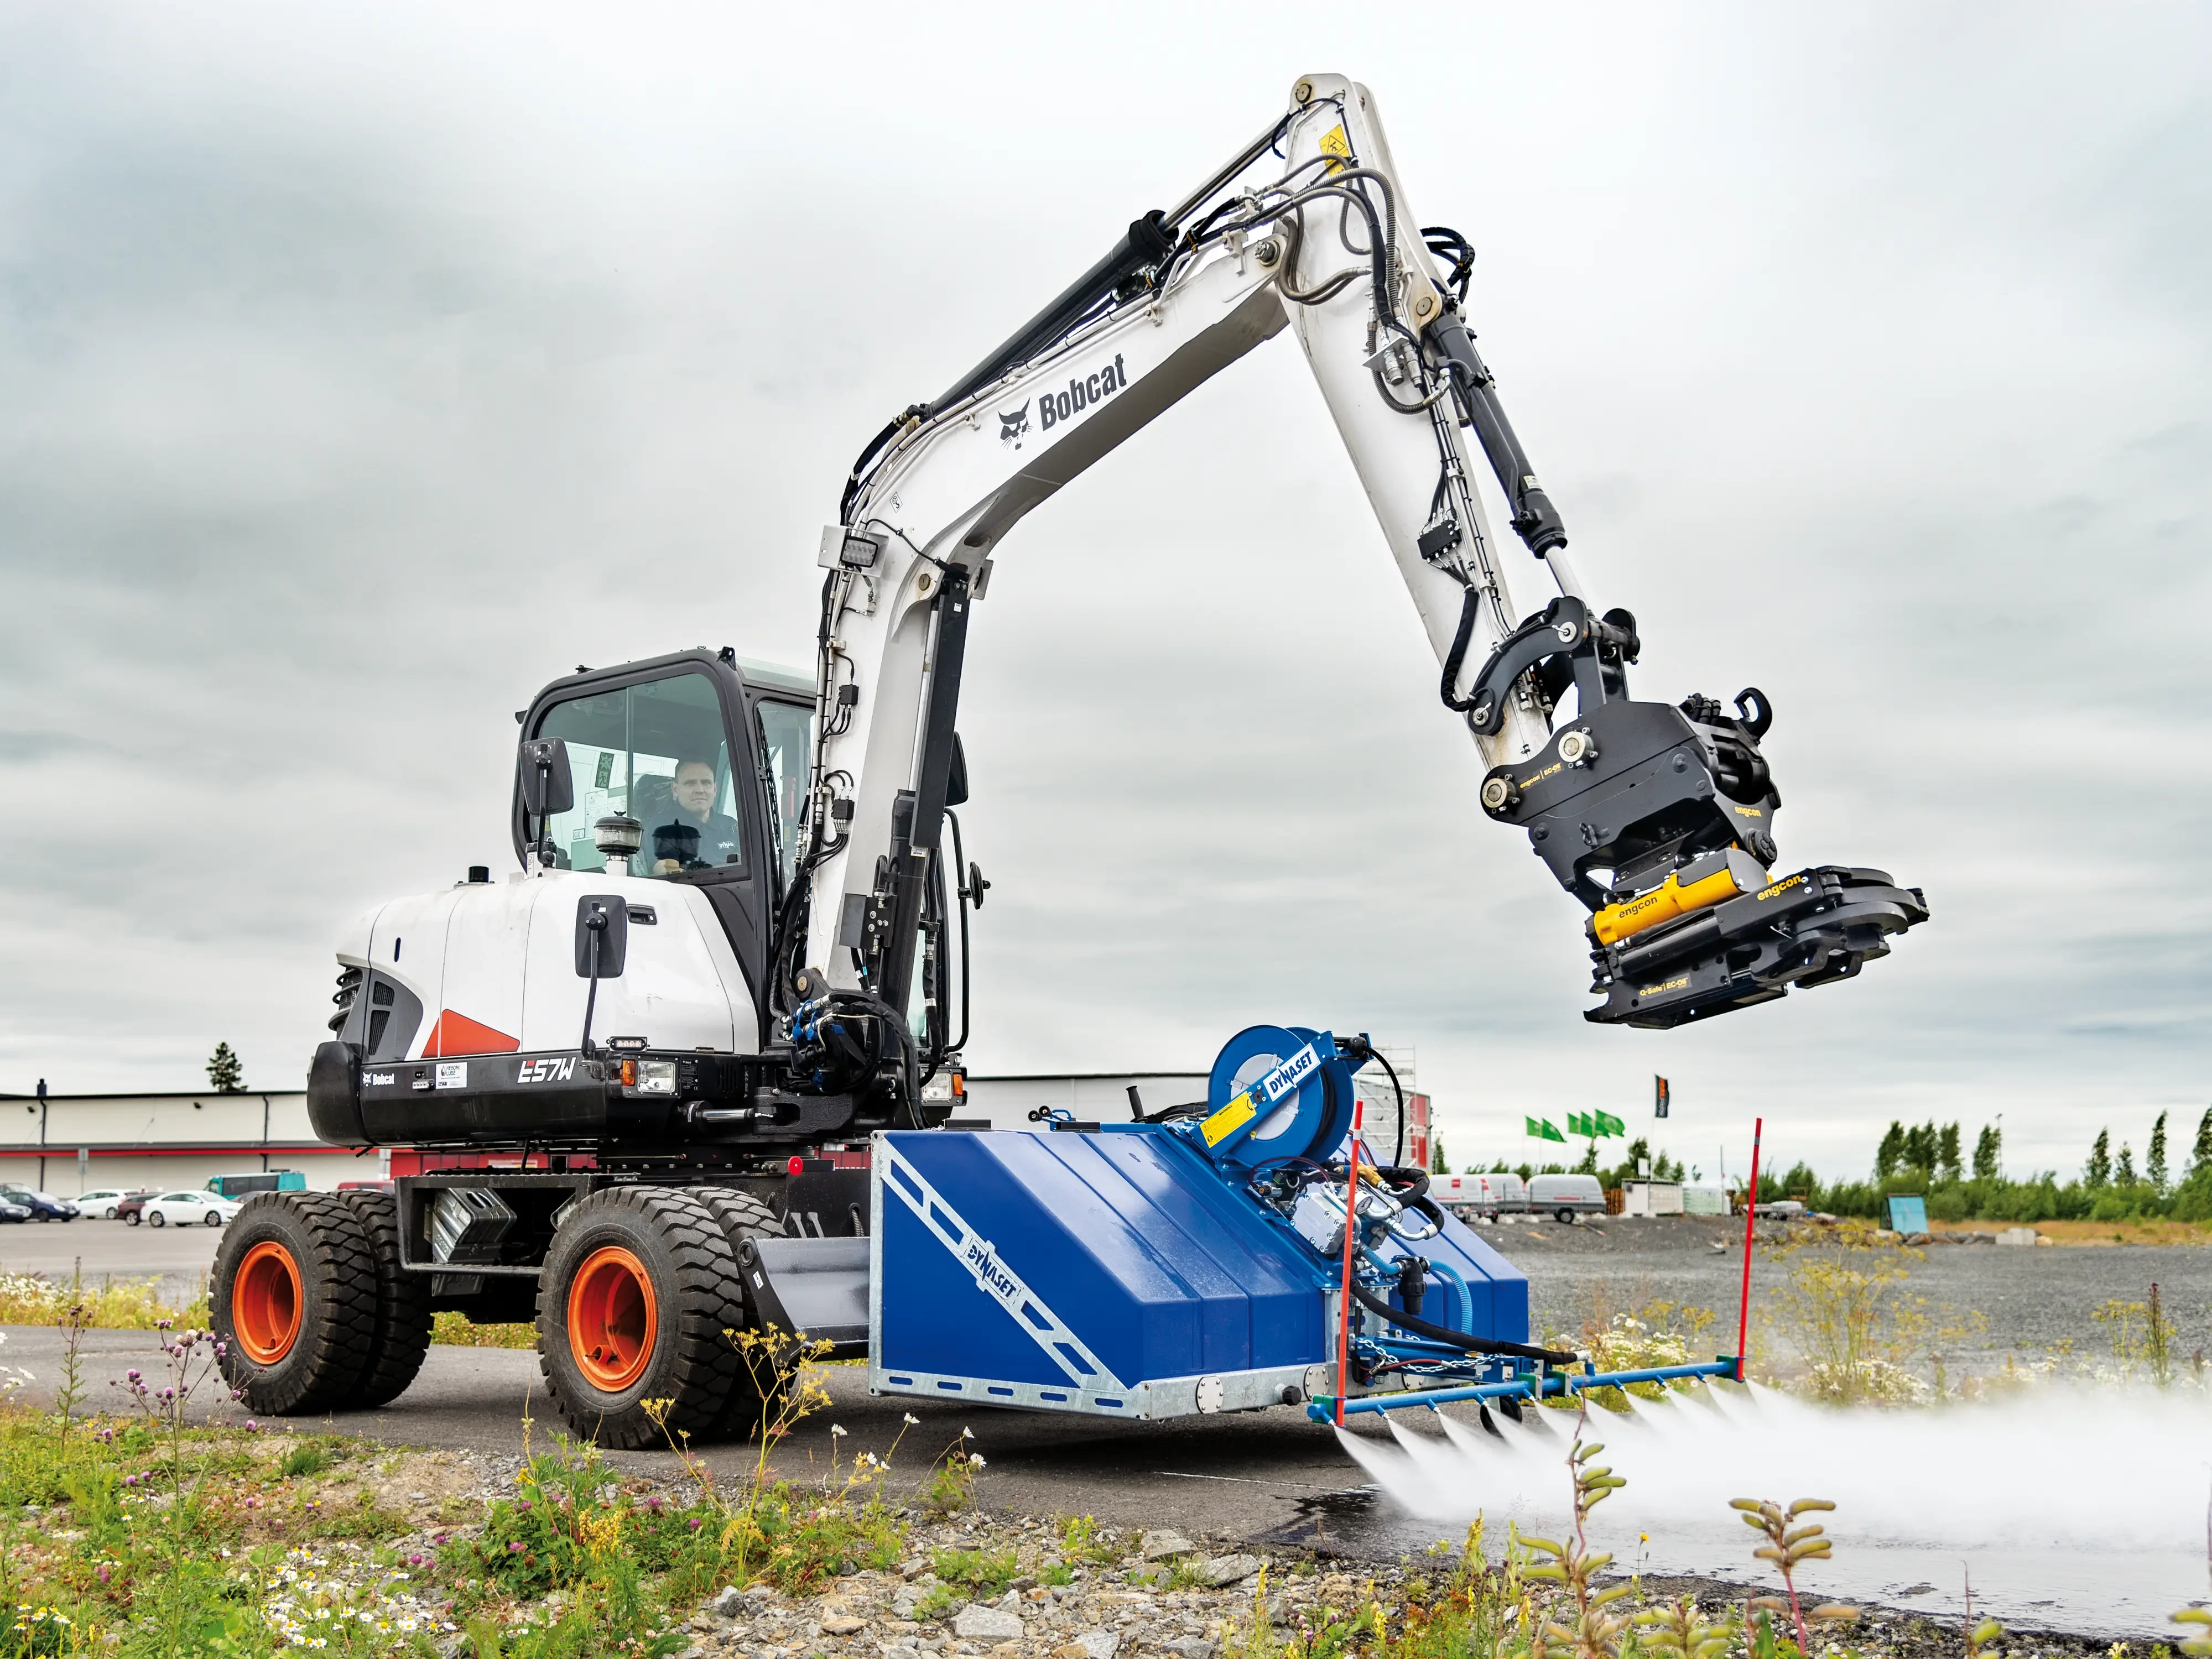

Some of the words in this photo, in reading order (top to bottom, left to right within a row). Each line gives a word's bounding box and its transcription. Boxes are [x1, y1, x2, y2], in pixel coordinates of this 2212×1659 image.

[1039, 353, 1127, 431] Bobcat
[1520, 775, 1540, 788] engcon
[1735, 806, 1761, 817] engcon
[1757, 874, 1801, 901] engcon
[1619, 896, 1658, 919] engcon
[1640, 985, 1663, 996] Q-Safe
[373, 1073, 394, 1085] Bobcat
[517, 1057, 576, 1083] E57W
[1269, 1051, 1312, 1093] DYNASET
[967, 1244, 1017, 1298] DYNASET
